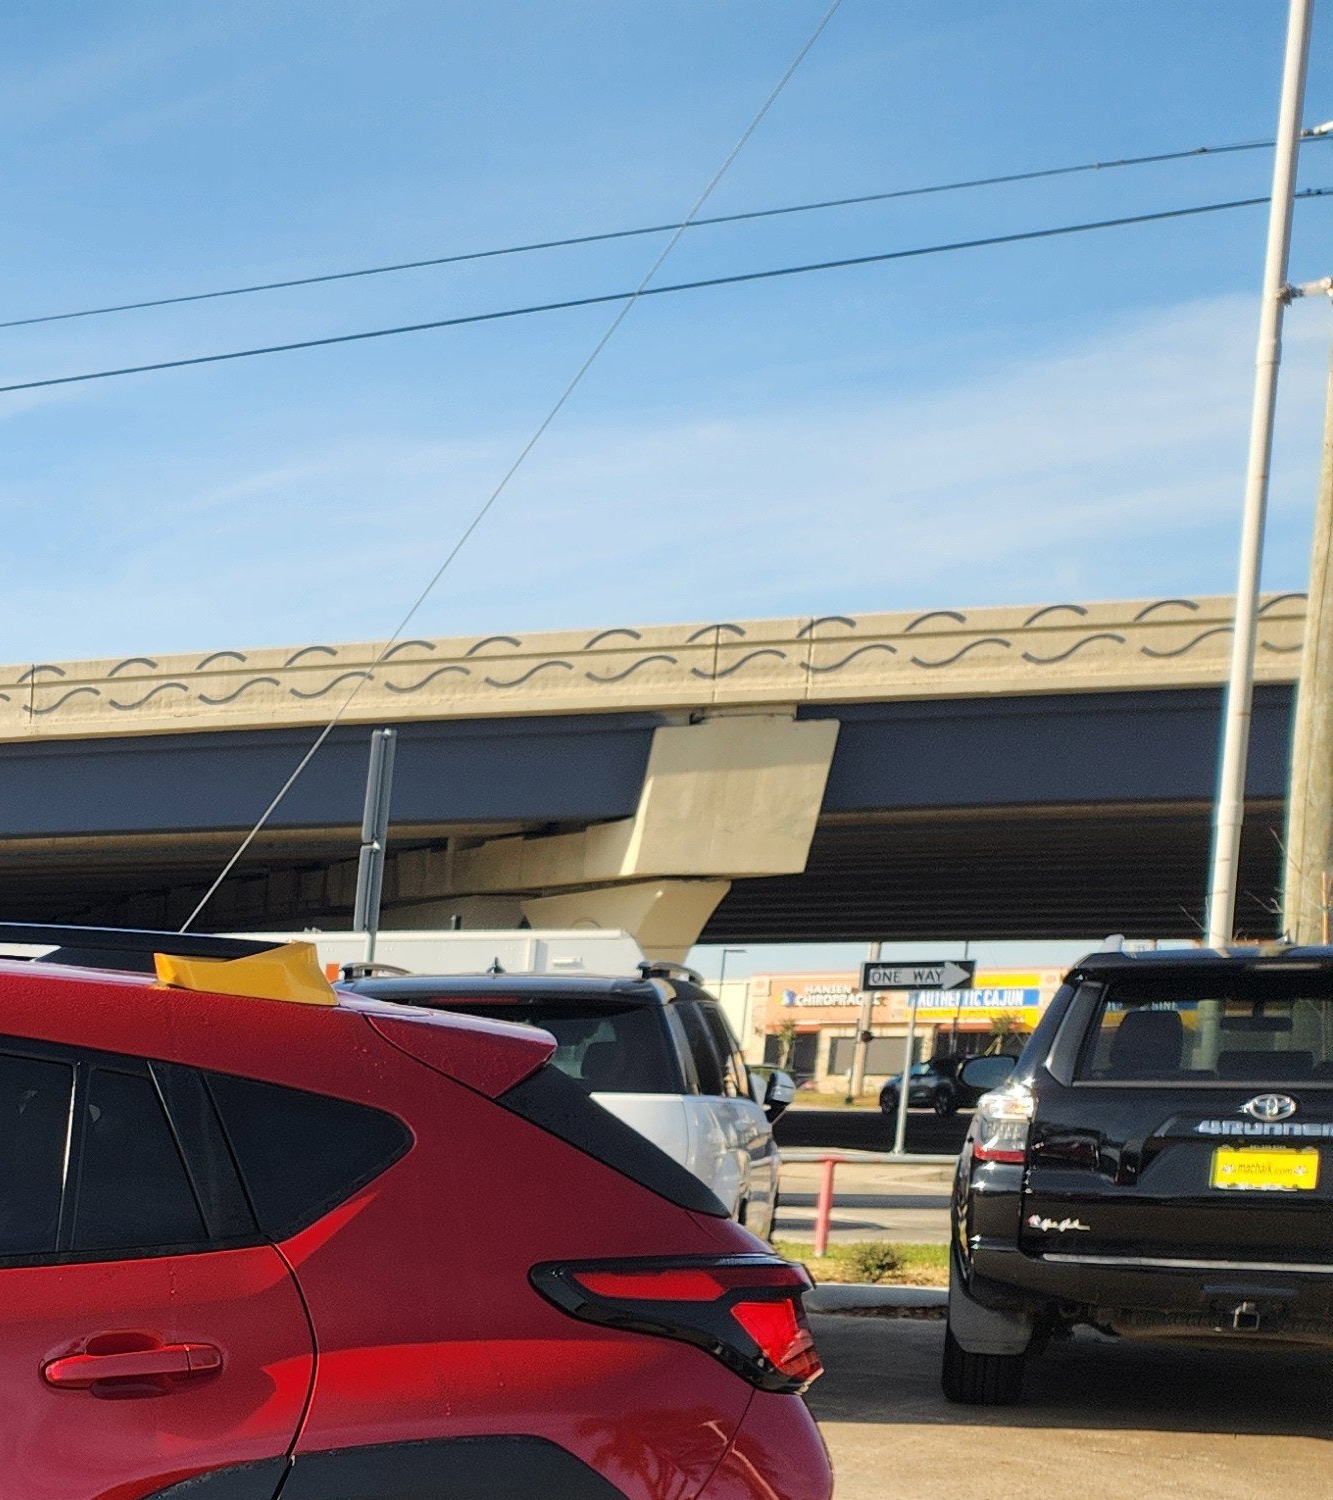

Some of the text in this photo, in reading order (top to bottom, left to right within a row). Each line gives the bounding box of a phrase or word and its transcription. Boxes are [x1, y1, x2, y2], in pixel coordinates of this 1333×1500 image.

[871, 969, 944, 984] ONE WAY
[983, 989, 1024, 1006] CAJUN
